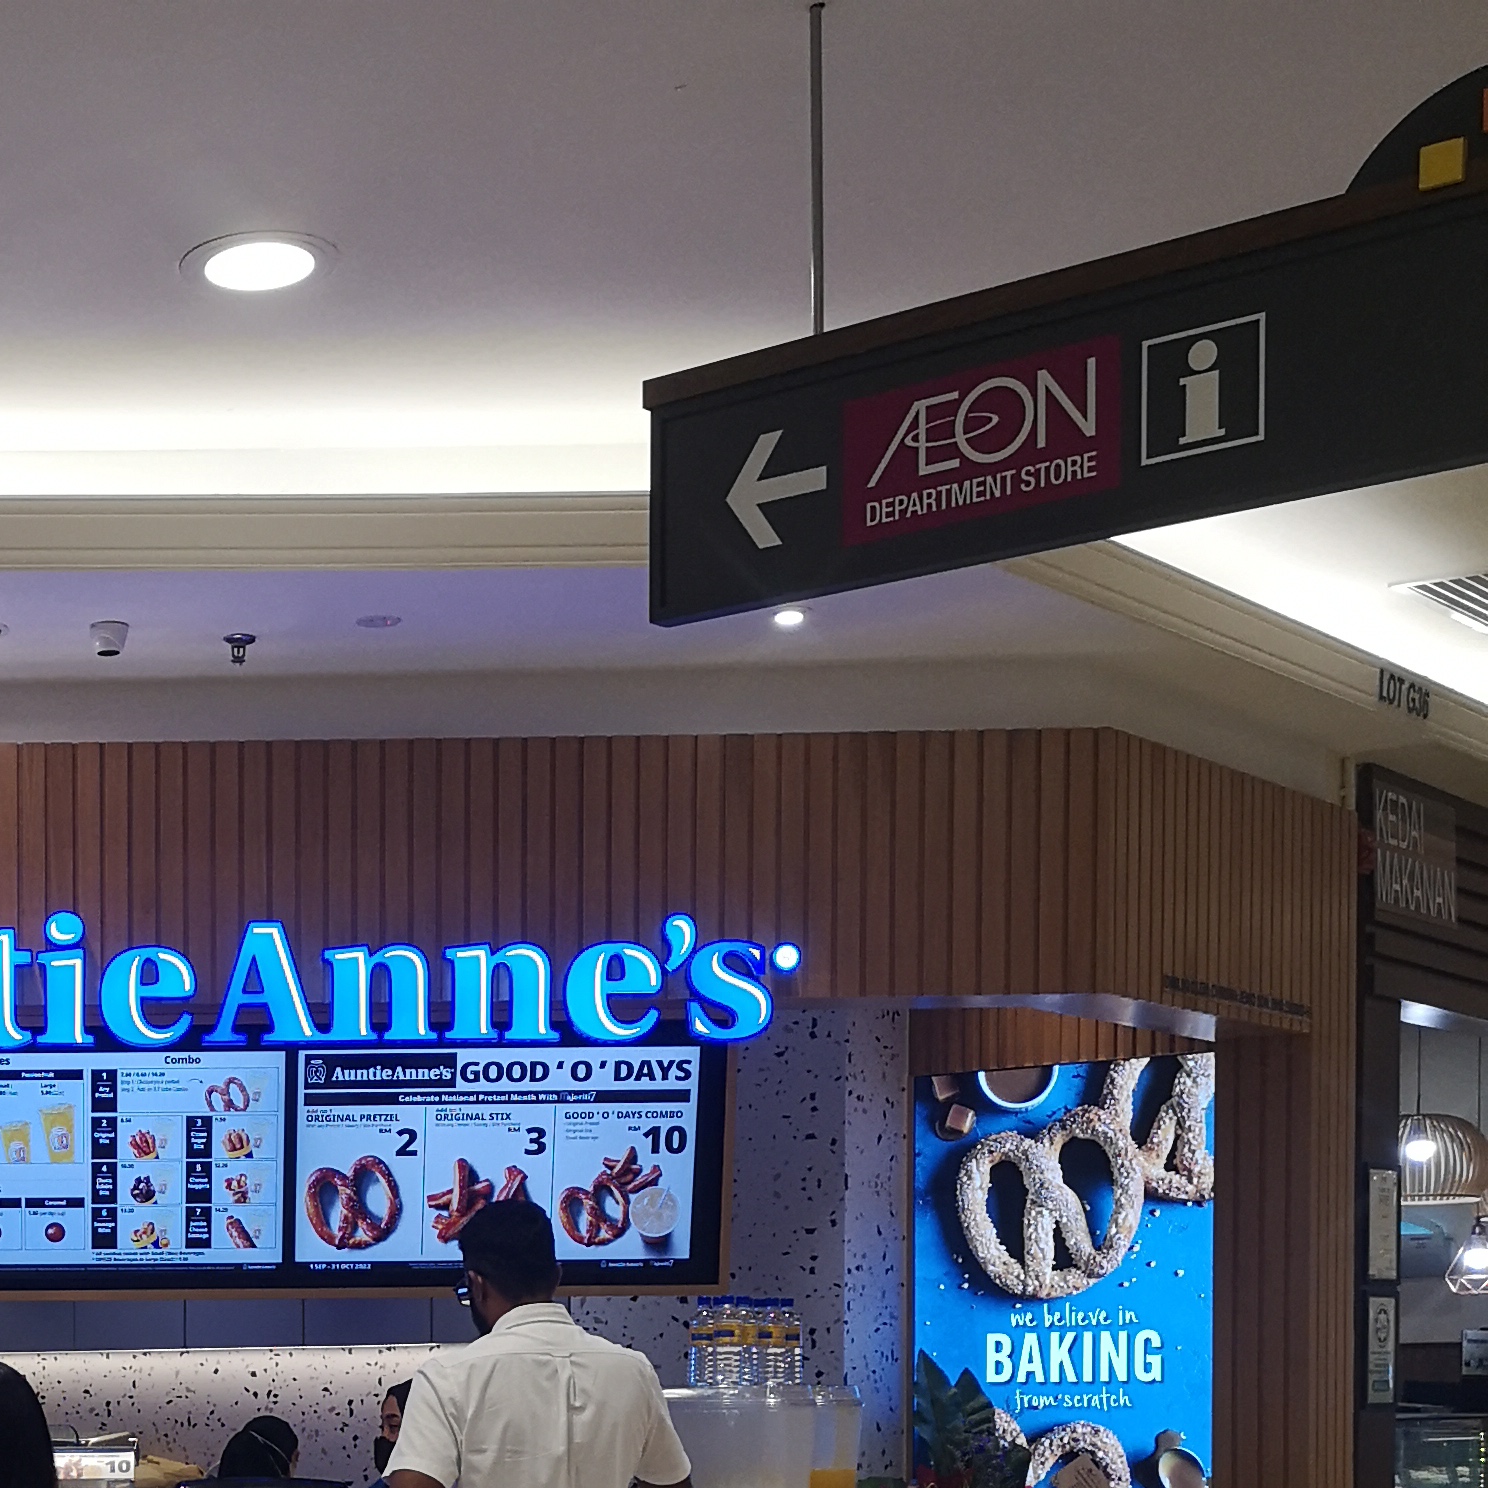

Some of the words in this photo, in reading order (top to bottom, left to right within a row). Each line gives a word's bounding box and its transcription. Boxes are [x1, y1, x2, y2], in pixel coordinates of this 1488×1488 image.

[866, 469, 1016, 528] DEPARTMENT
[1020, 450, 1098, 493] STORE
[1378, 668, 1405, 708] LOT
[1376, 787, 1424, 855] KEDAI
[1376, 848, 1456, 924] MAKANAN
[164, 1055, 202, 1065] Combo
[460, 1060, 550, 1083] GOOD
[613, 1059, 693, 1082] DAYS
[398, 1094, 440, 1102] Celebrate
[441, 1094, 477, 1102] National
[478, 1093, 509, 1102] Pretzel
[538, 1093, 558, 1101] With
[101, 1119, 107, 1127] 2
[306, 1114, 358, 1123] ORIGINAL
[359, 1113, 401, 1122] PRETZEL
[435, 1113, 486, 1122] ORIGINAL
[488, 1112, 512, 1121] STIX
[564, 1111, 595, 1120] GOOD
[616, 1110, 643, 1120] DAYS
[644, 1110, 684, 1119] COMBO
[395, 1127, 418, 1157] 2
[523, 1126, 547, 1156] 3
[642, 1125, 688, 1155] 10
[101, 1164, 108, 1172] 4
[195, 1208, 202, 1216] 7
[1010, 1310, 1038, 1328] we
[1043, 1301, 1112, 1328] believe
[1117, 1305, 1139, 1326] in
[985, 1328, 1163, 1384] BAKING
[1014, 1387, 1058, 1414] from
[1062, 1386, 1133, 1412] scratch
[105, 1459, 131, 1474] 10
